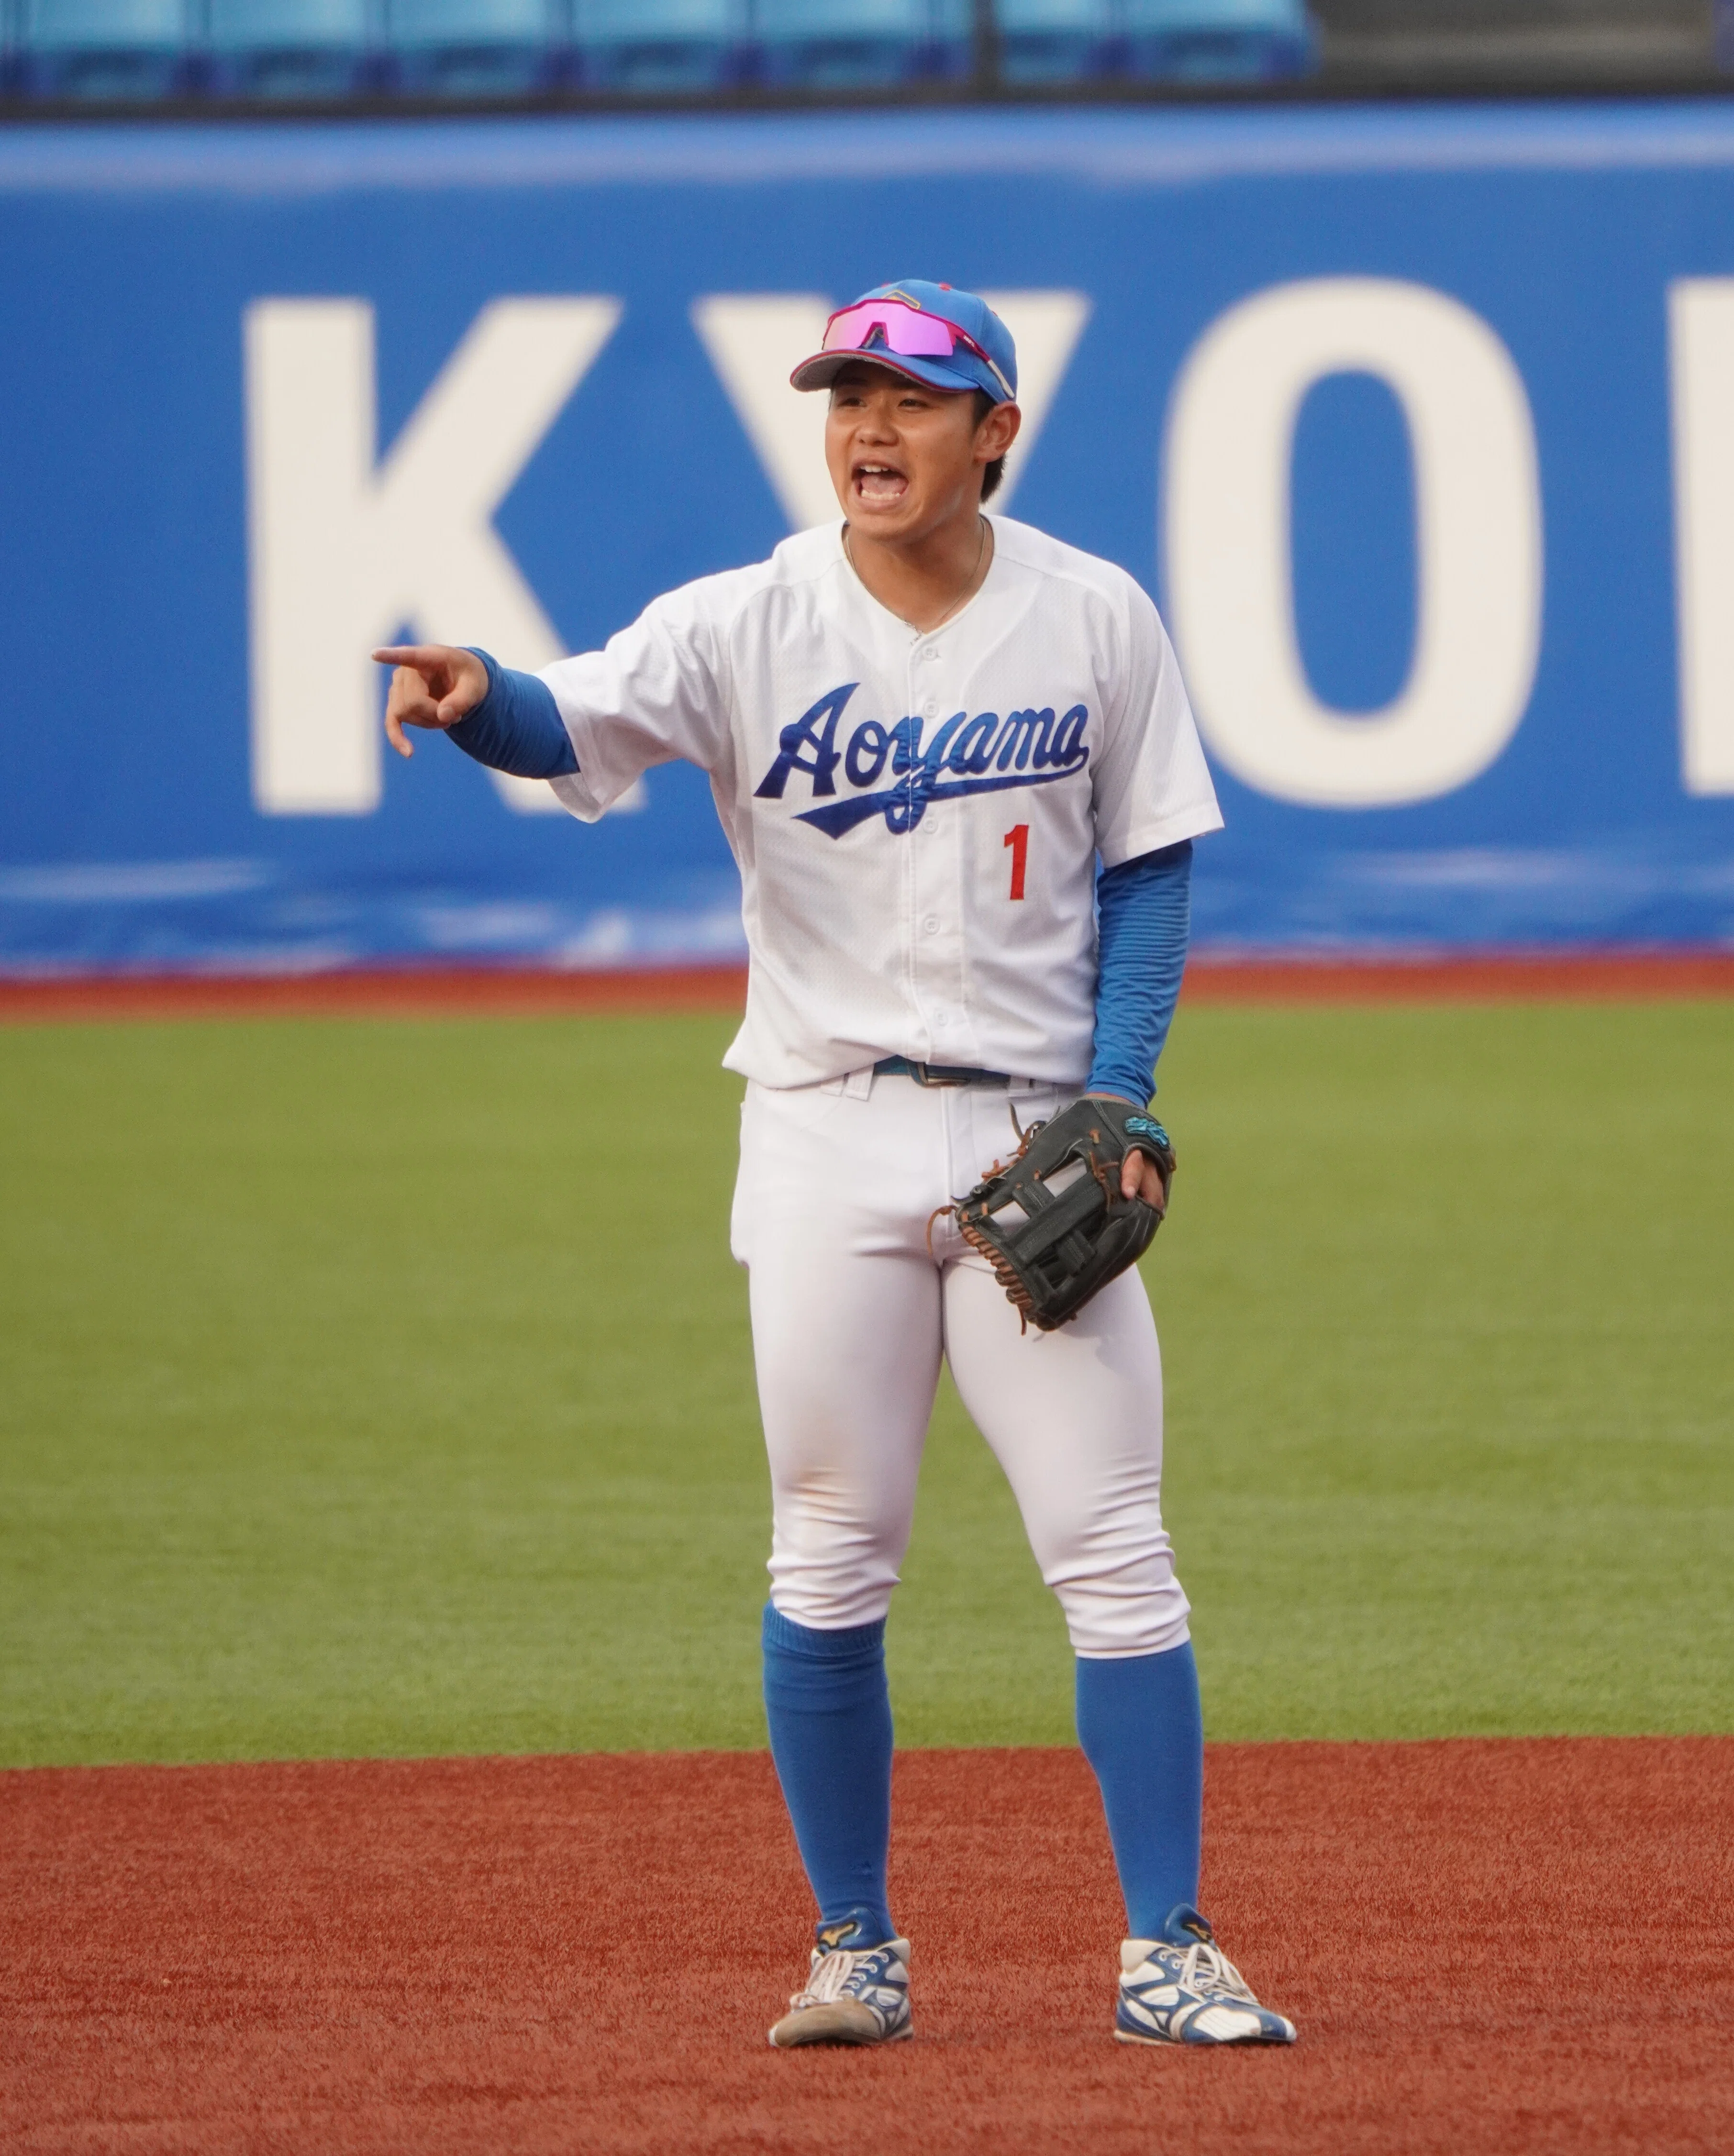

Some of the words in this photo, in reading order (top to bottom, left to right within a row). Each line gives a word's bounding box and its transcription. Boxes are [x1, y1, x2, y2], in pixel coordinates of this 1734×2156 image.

[243, 276, 1734, 816] KO
[753, 682, 1090, 840] Aoyama
[1004, 824, 1029, 900] 1
